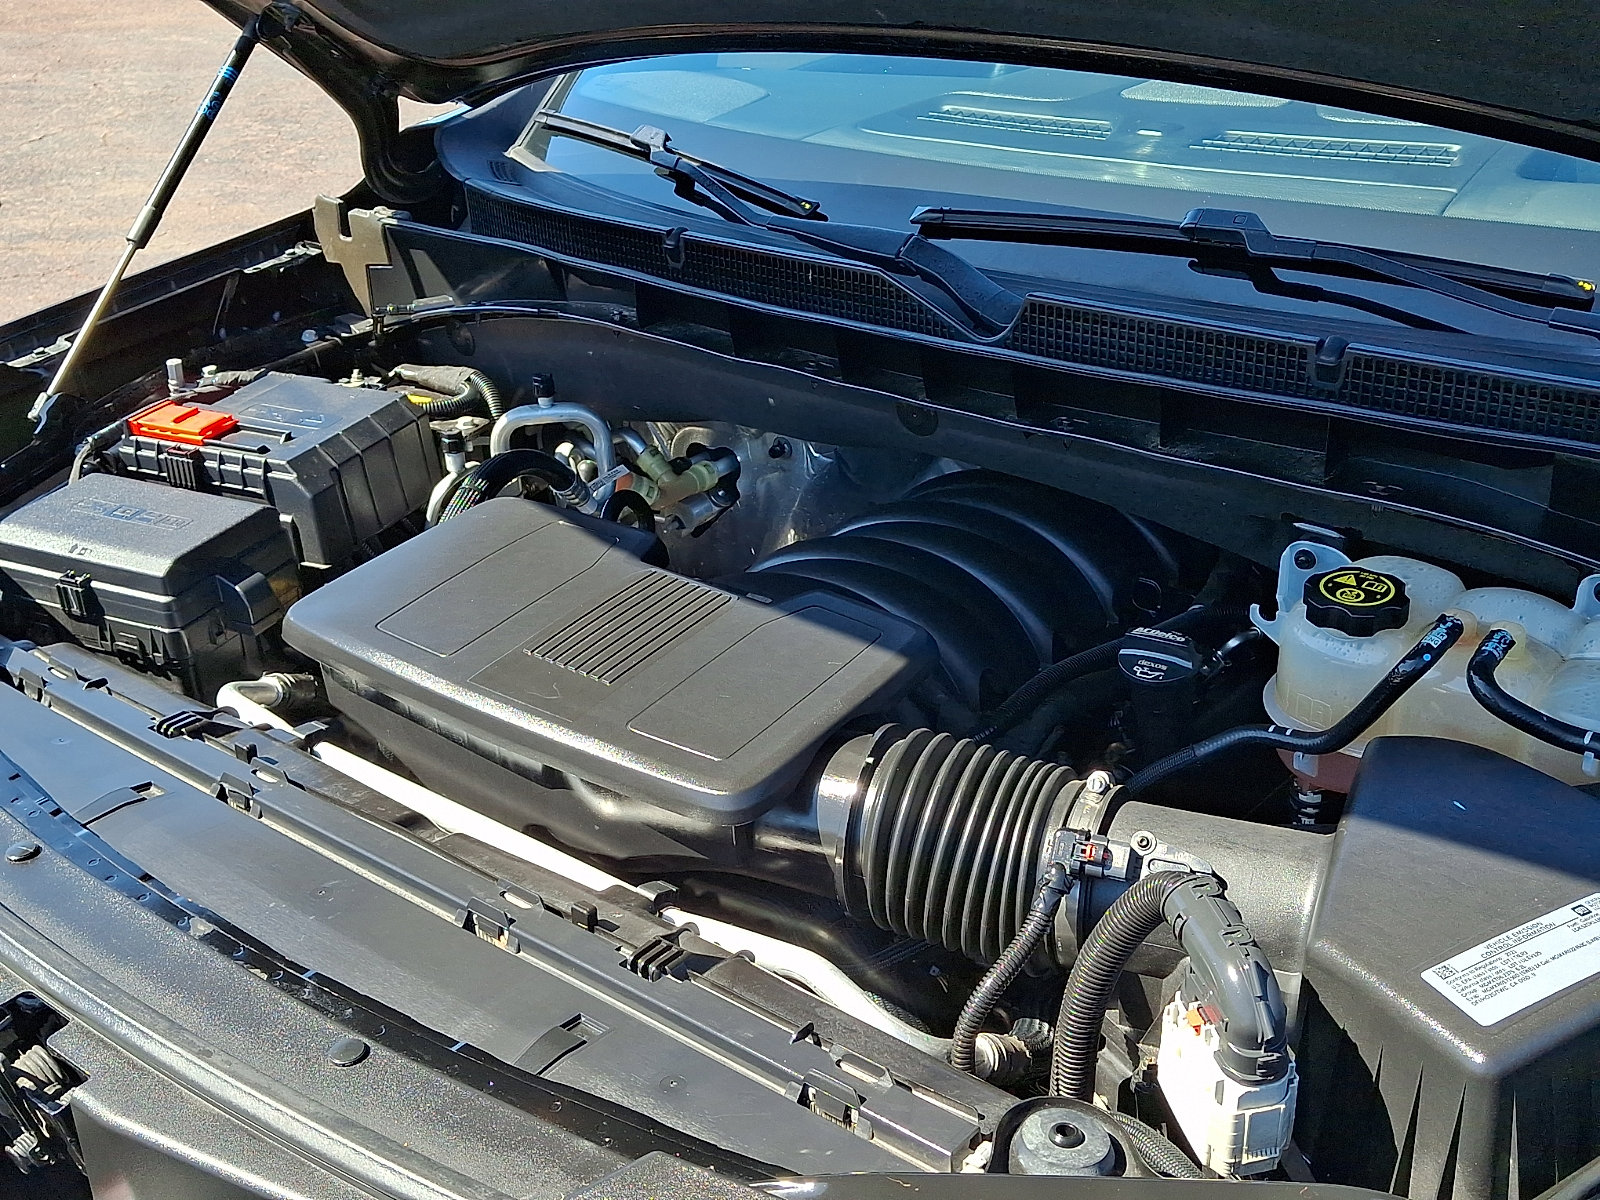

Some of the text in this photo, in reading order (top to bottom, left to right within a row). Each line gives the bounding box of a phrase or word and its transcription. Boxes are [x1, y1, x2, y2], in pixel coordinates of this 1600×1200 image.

[1137, 659, 1168, 670] dexos
[1479, 941, 1513, 958] CONTROL
[1511, 921, 1557, 944] INFORMATION
[1483, 920, 1544, 950] VEHICLE EMISSION
